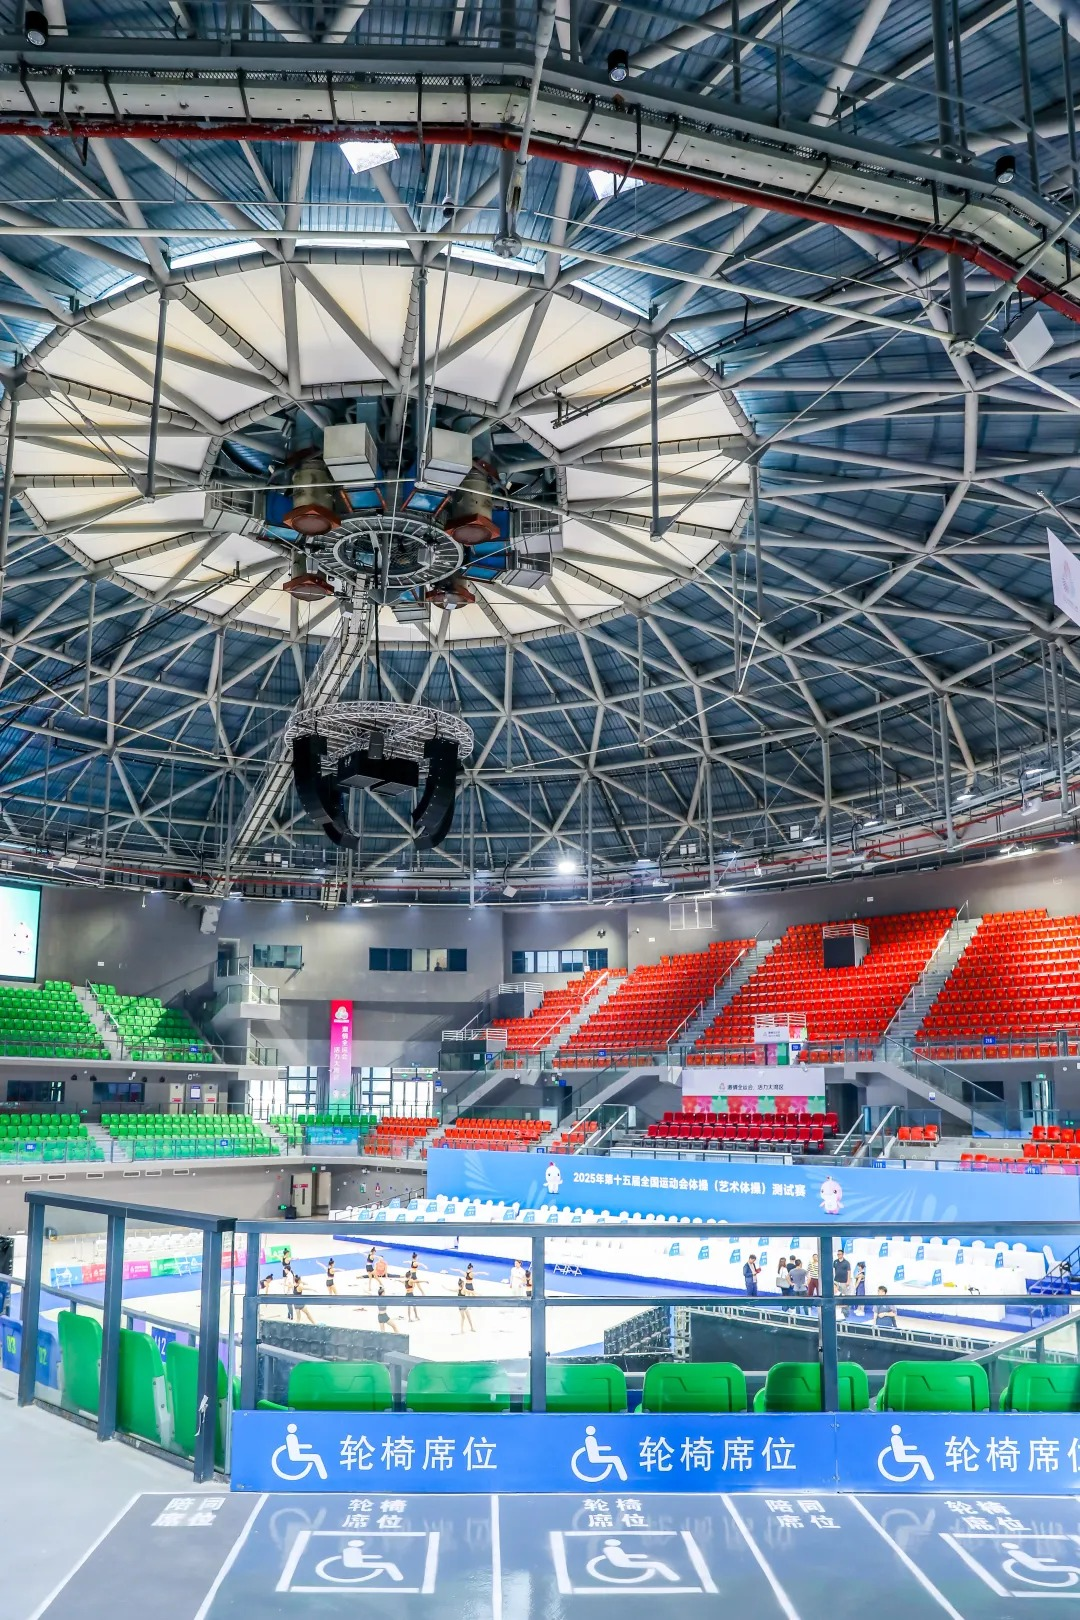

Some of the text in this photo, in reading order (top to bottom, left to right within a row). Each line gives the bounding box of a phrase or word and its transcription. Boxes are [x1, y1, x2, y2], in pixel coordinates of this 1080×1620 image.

[573, 1172, 806, 1197] 2025年第十五届全国运动会体操（艺术体操）测试赛
[339, 1435, 498, 1471] 轮椅席位
[639, 1436, 797, 1472] 轮椅席位
[347, 1499, 407, 1512] 轮椅
[582, 1499, 642, 1511] 轮椅
[764, 1500, 826, 1513] 陪同
[944, 1501, 1011, 1515] 轮椅
[342, 1514, 403, 1528] 席位
[588, 1514, 649, 1527] 席位
[776, 1515, 841, 1529] 席位
[962, 1516, 1032, 1531] 席位
